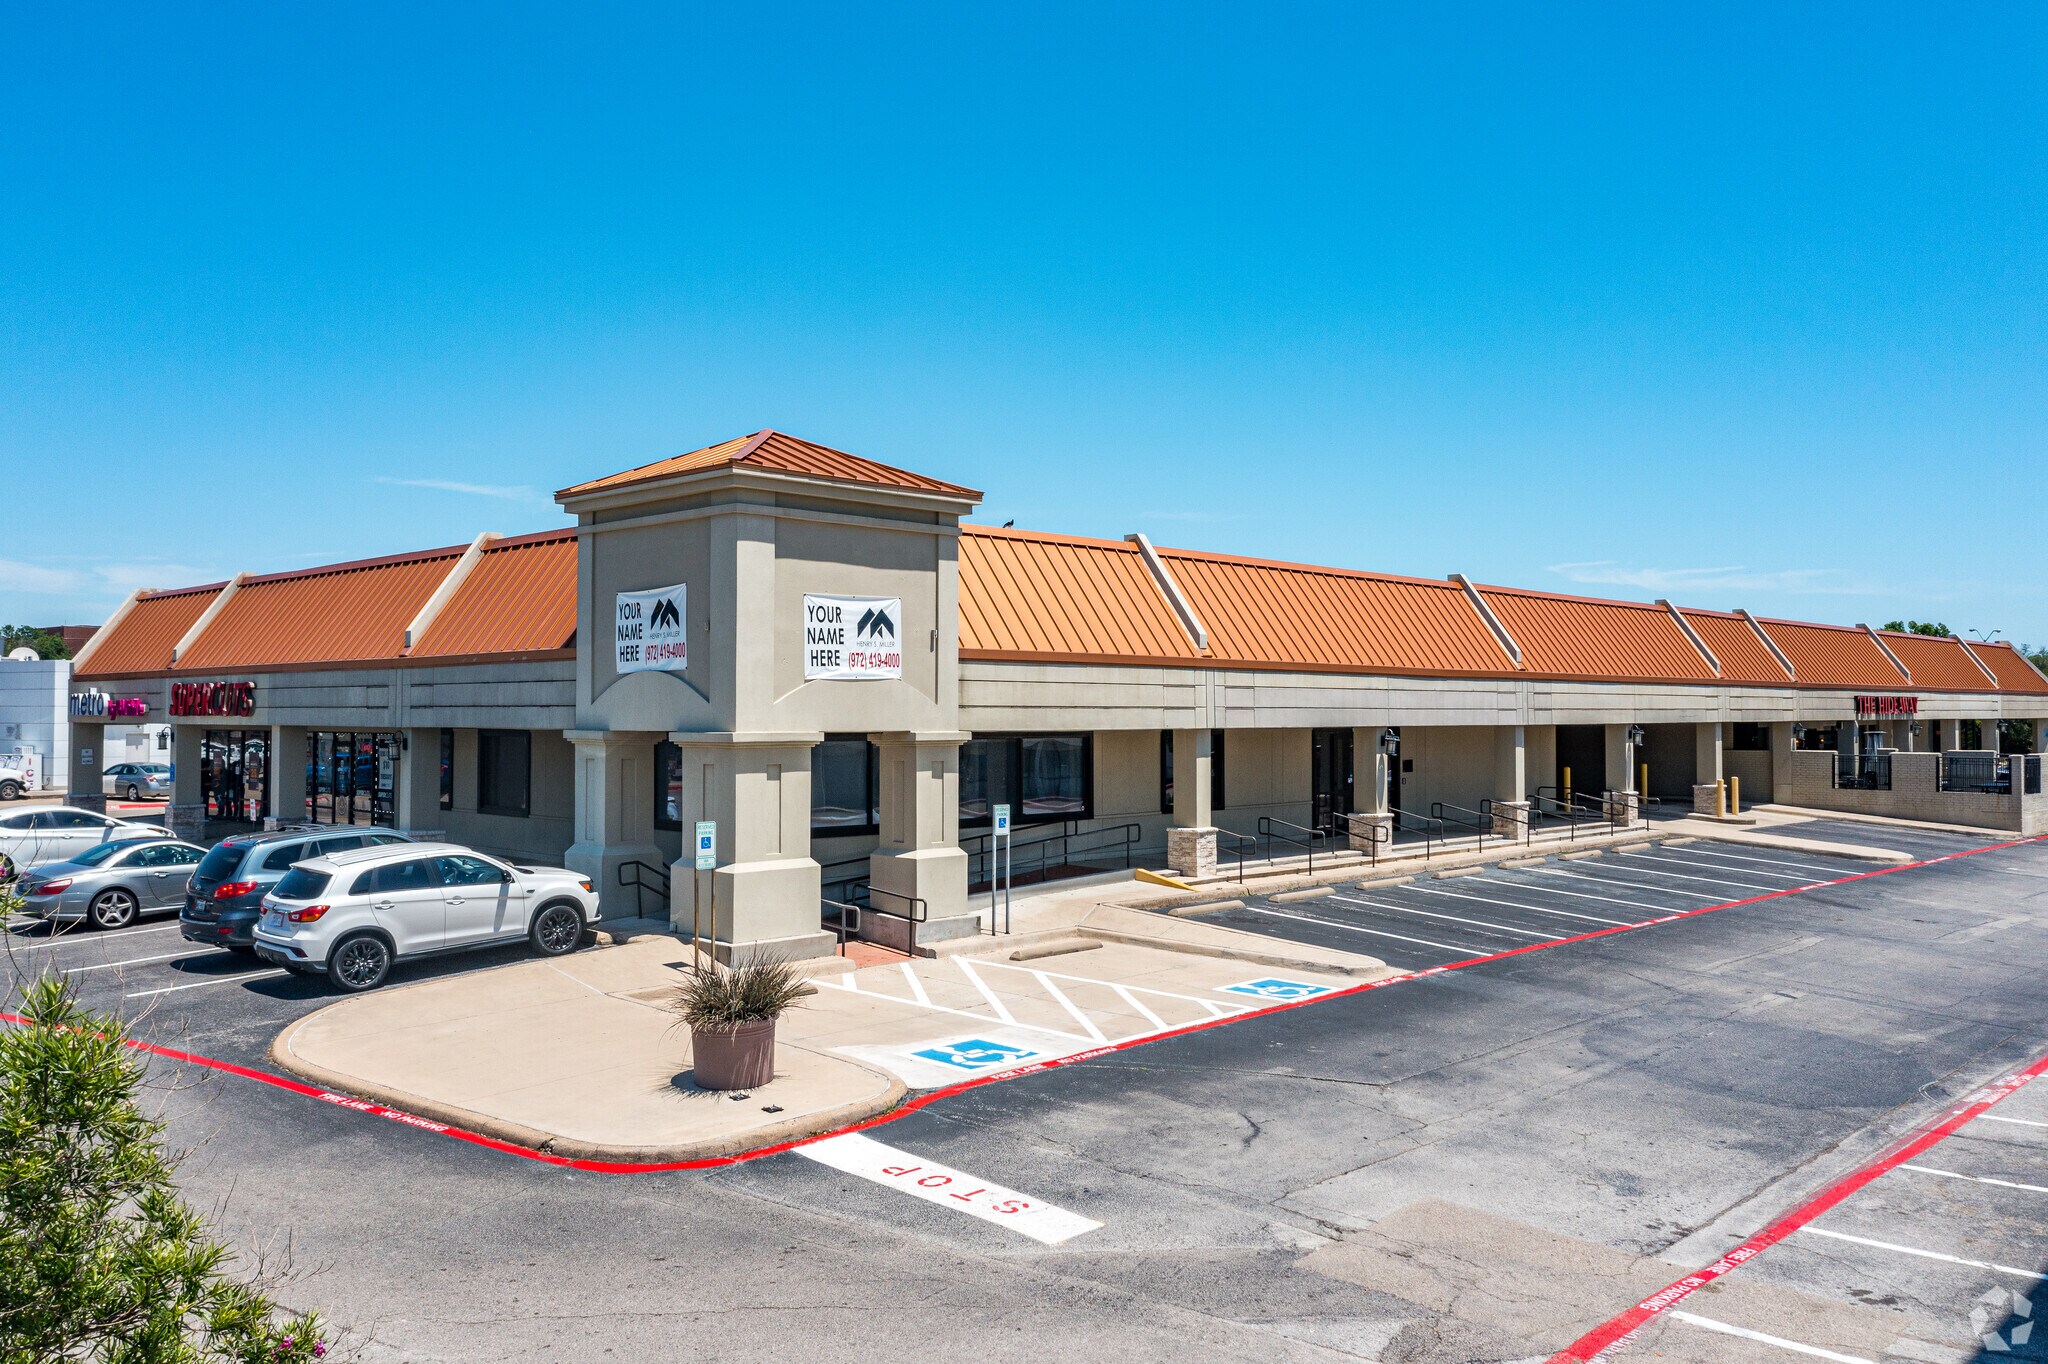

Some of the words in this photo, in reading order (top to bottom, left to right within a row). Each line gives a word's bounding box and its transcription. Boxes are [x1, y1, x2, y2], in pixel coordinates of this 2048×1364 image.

[619, 603, 642, 620] YOUR
[807, 605, 842, 623] YOUR
[618, 623, 643, 641] NAME
[807, 627, 845, 645] NAME
[620, 645, 640, 662] HERE
[645, 645, 659, 665] (972)
[660, 642, 686, 660] 419-4000
[810, 650, 841, 667] HERE
[848, 652, 868, 671] (972)
[869, 652, 900, 668] 419-4000
[70, 688, 104, 715] metro
[169, 682, 254, 717] SUPERCUTS
[1858, 696, 1876, 714] THE
[1879, 696, 1918, 714] HIDEAWAY
[317, 1092, 343, 1104] FIRE
[341, 1099, 374, 1111] LANE
[380, 1110, 398, 1119] NO
[398, 1115, 449, 1132] PARKING
[882, 1166, 1030, 1214] STOP
[1728, 1247, 1758, 1262] FIRE
[1704, 1259, 1740, 1275] LANE
[1681, 1276, 1706, 1288] NO
[1640, 1284, 1691, 1312] PARKING
